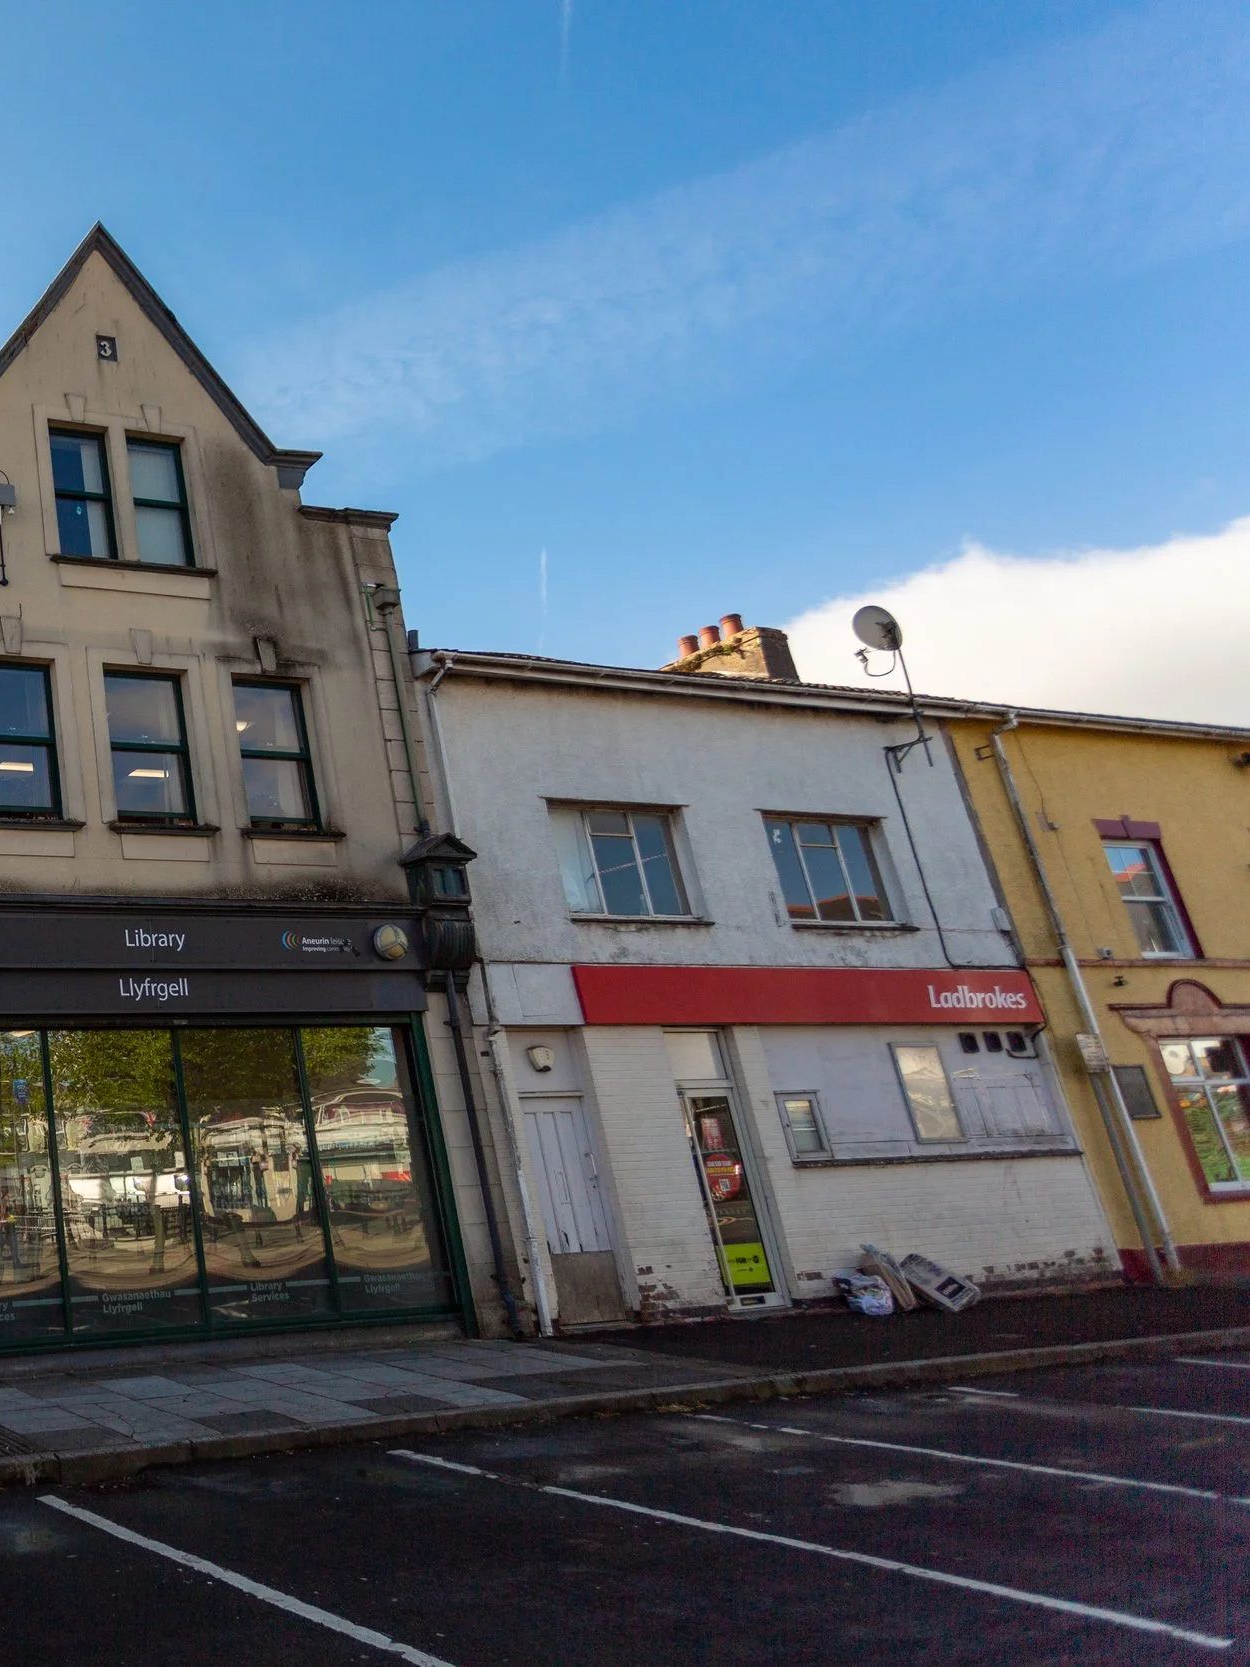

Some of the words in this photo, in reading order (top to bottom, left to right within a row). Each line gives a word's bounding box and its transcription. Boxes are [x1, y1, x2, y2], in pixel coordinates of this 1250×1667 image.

[100, 341, 112, 357] 3
[125, 929, 185, 951] Library
[301, 937, 330, 945] Aneurin
[119, 978, 189, 1000] Llyfrgell
[927, 985, 1027, 1009] Ladbrokes
[250, 1281, 283, 1293] Library
[102, 1290, 171, 1302] Gwasanaethau
[251, 1291, 290, 1302] Services
[102, 1302, 143, 1315] Llyfrgell
